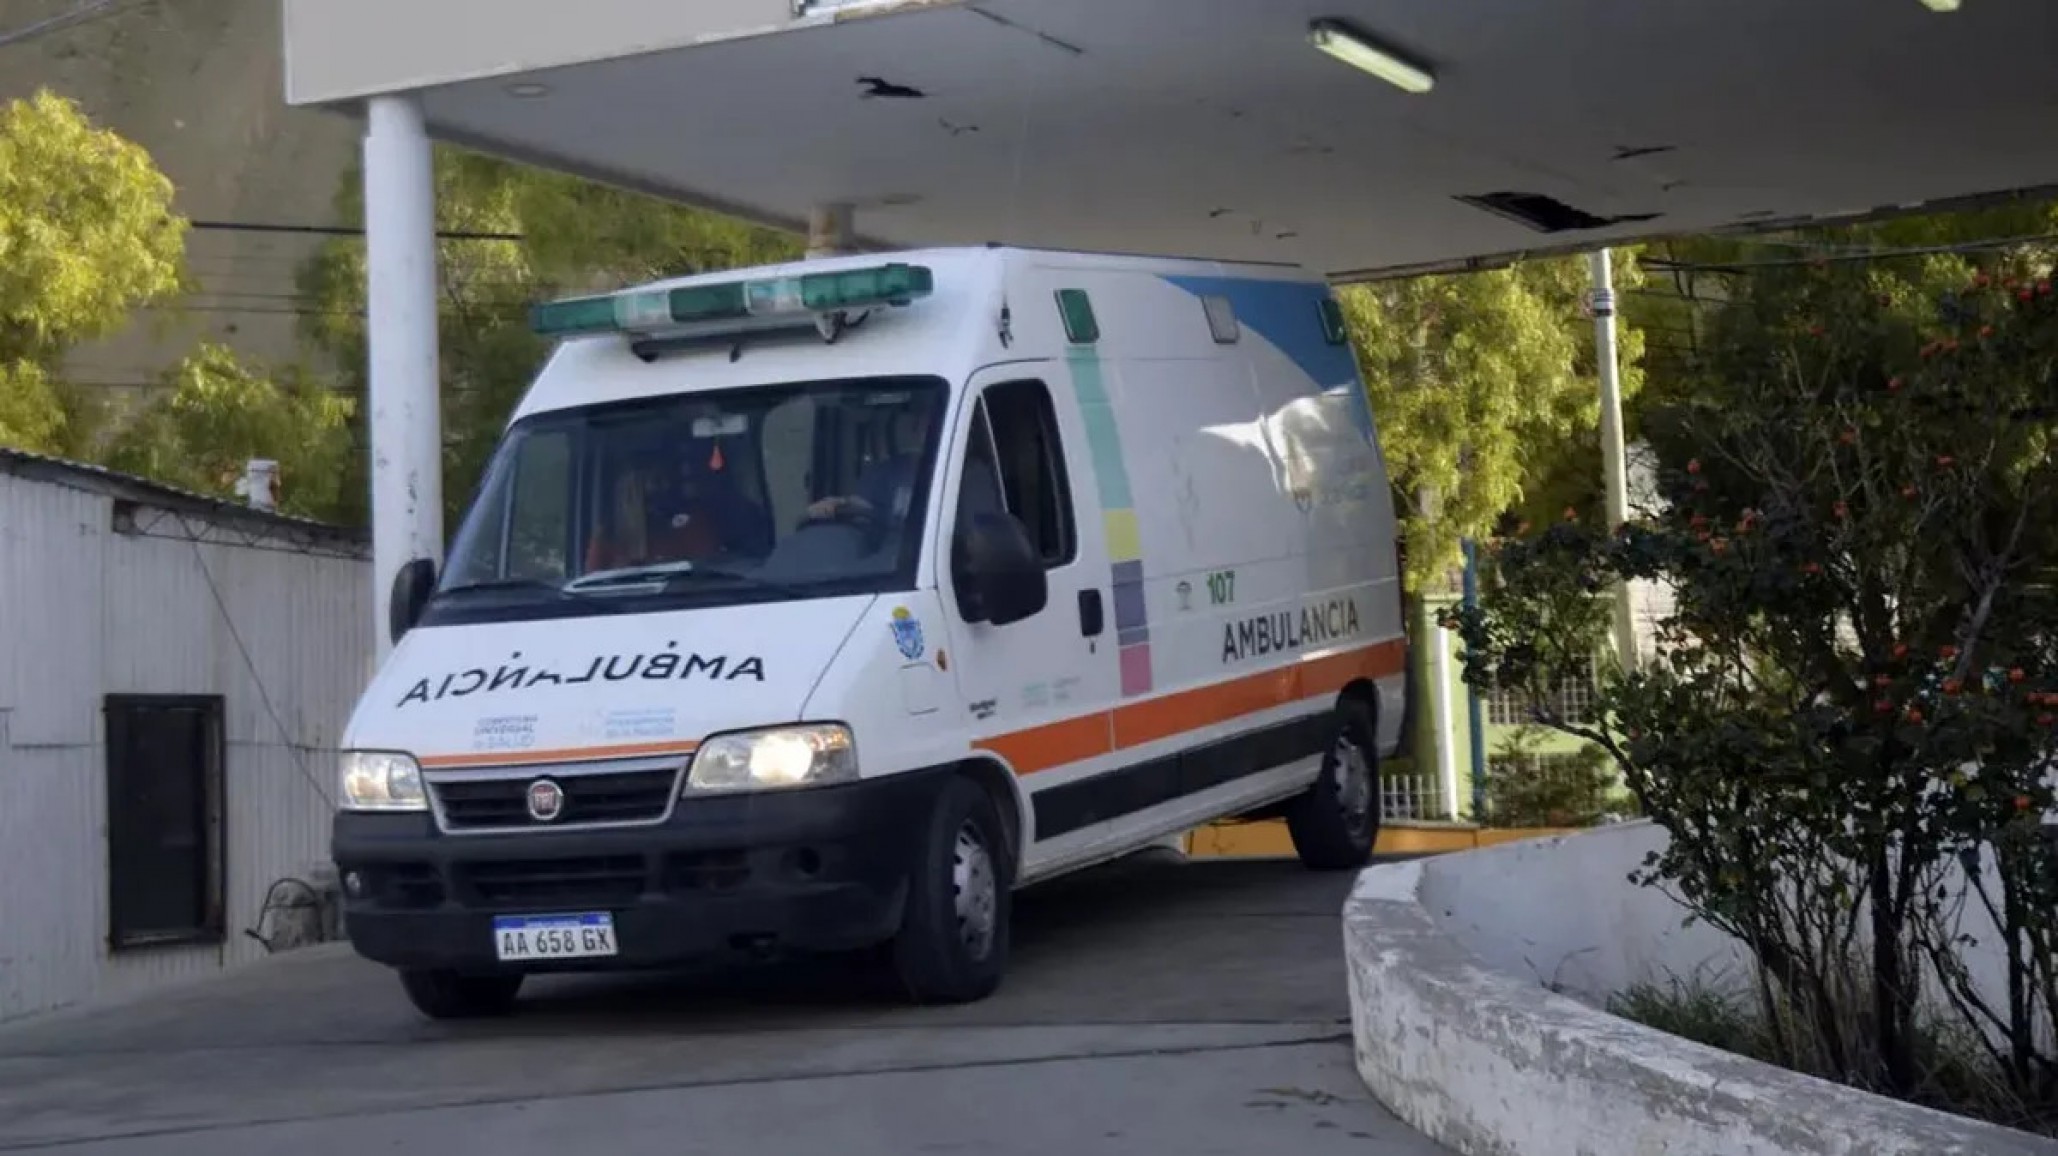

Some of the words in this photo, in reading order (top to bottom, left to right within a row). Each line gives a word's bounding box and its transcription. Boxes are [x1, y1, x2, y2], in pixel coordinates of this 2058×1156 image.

[1207, 570, 1236, 604] 107
[1222, 598, 1360, 663] AMBULANCIA
[503, 932, 530, 955] AA
[536, 930, 576, 953] 658
[582, 928, 611, 951] GX
